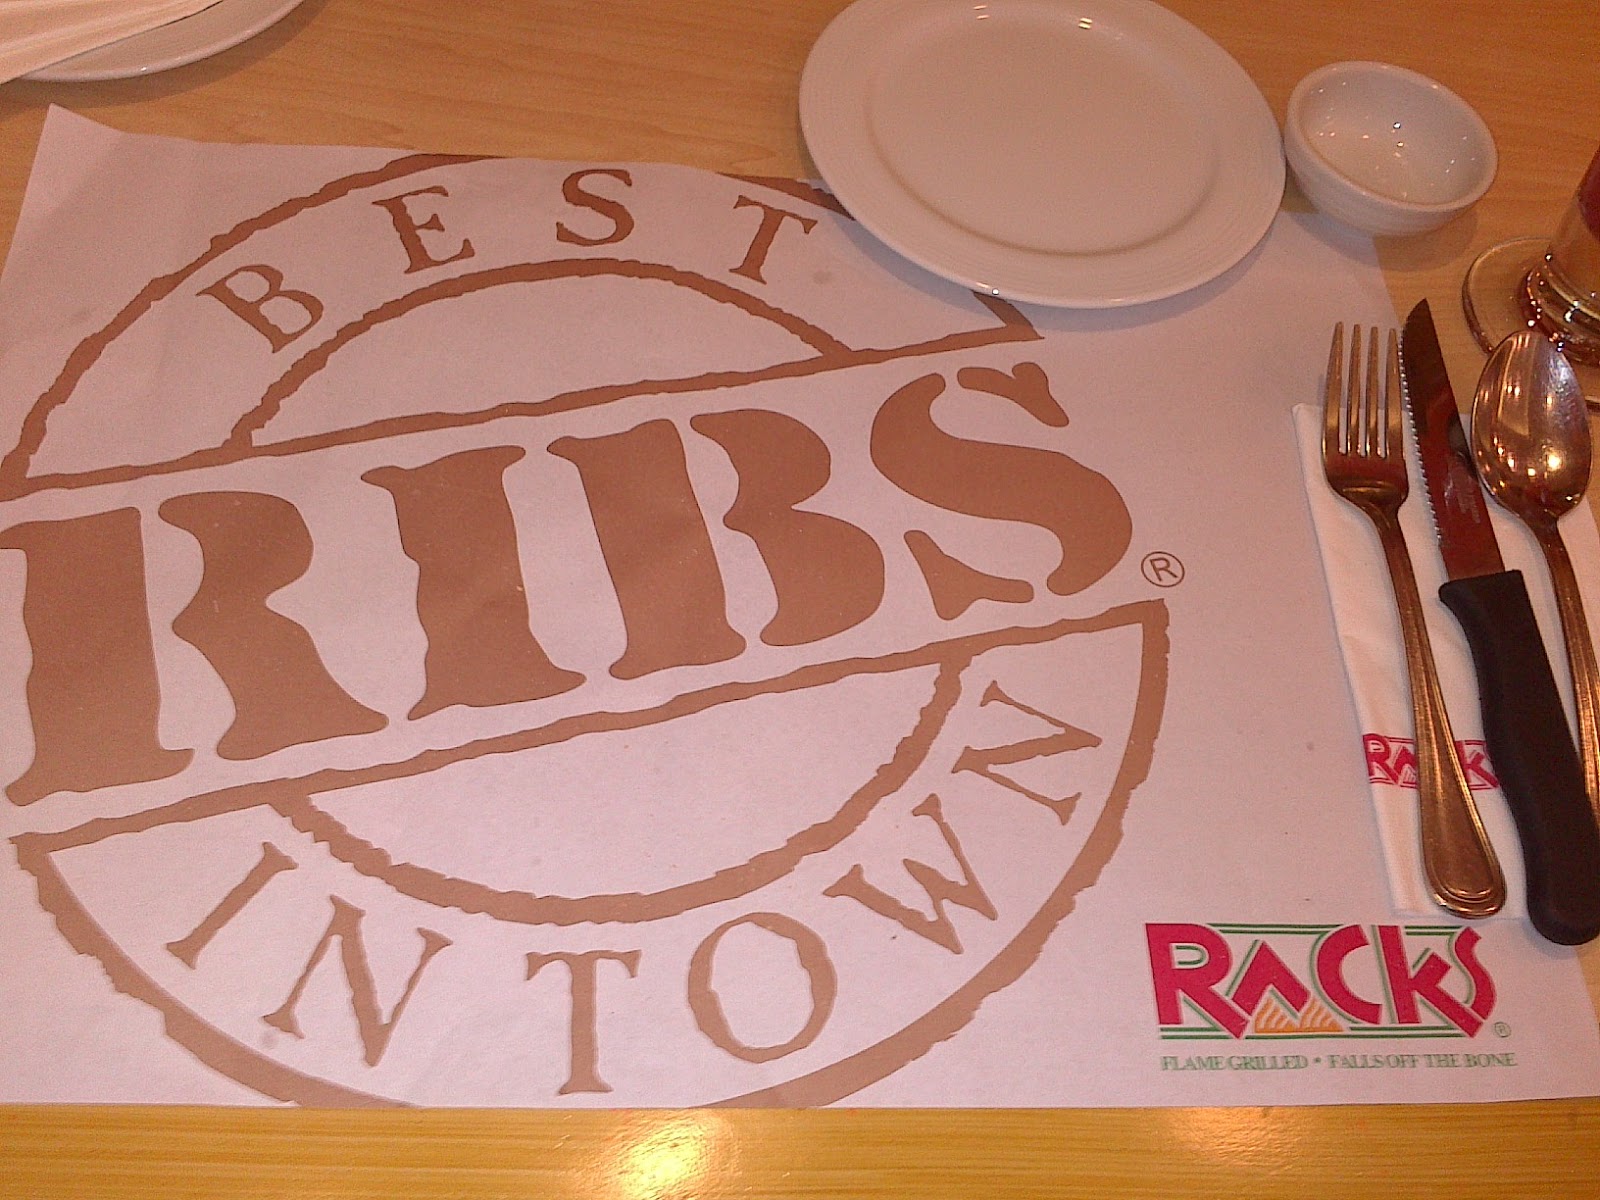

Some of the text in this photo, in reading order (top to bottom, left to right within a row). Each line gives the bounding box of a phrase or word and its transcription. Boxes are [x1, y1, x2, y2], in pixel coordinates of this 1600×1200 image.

[197, 169, 818, 353] BEST
[0, 362, 1133, 806] RIBS
[1363, 733, 1500, 790] RAK
[166, 681, 1102, 1095] IN TOWN
[1145, 922, 1497, 1039] RACKS
[1162, 1053, 1517, 1070] FLAME GRILLED FALLS OFF THE BONE
